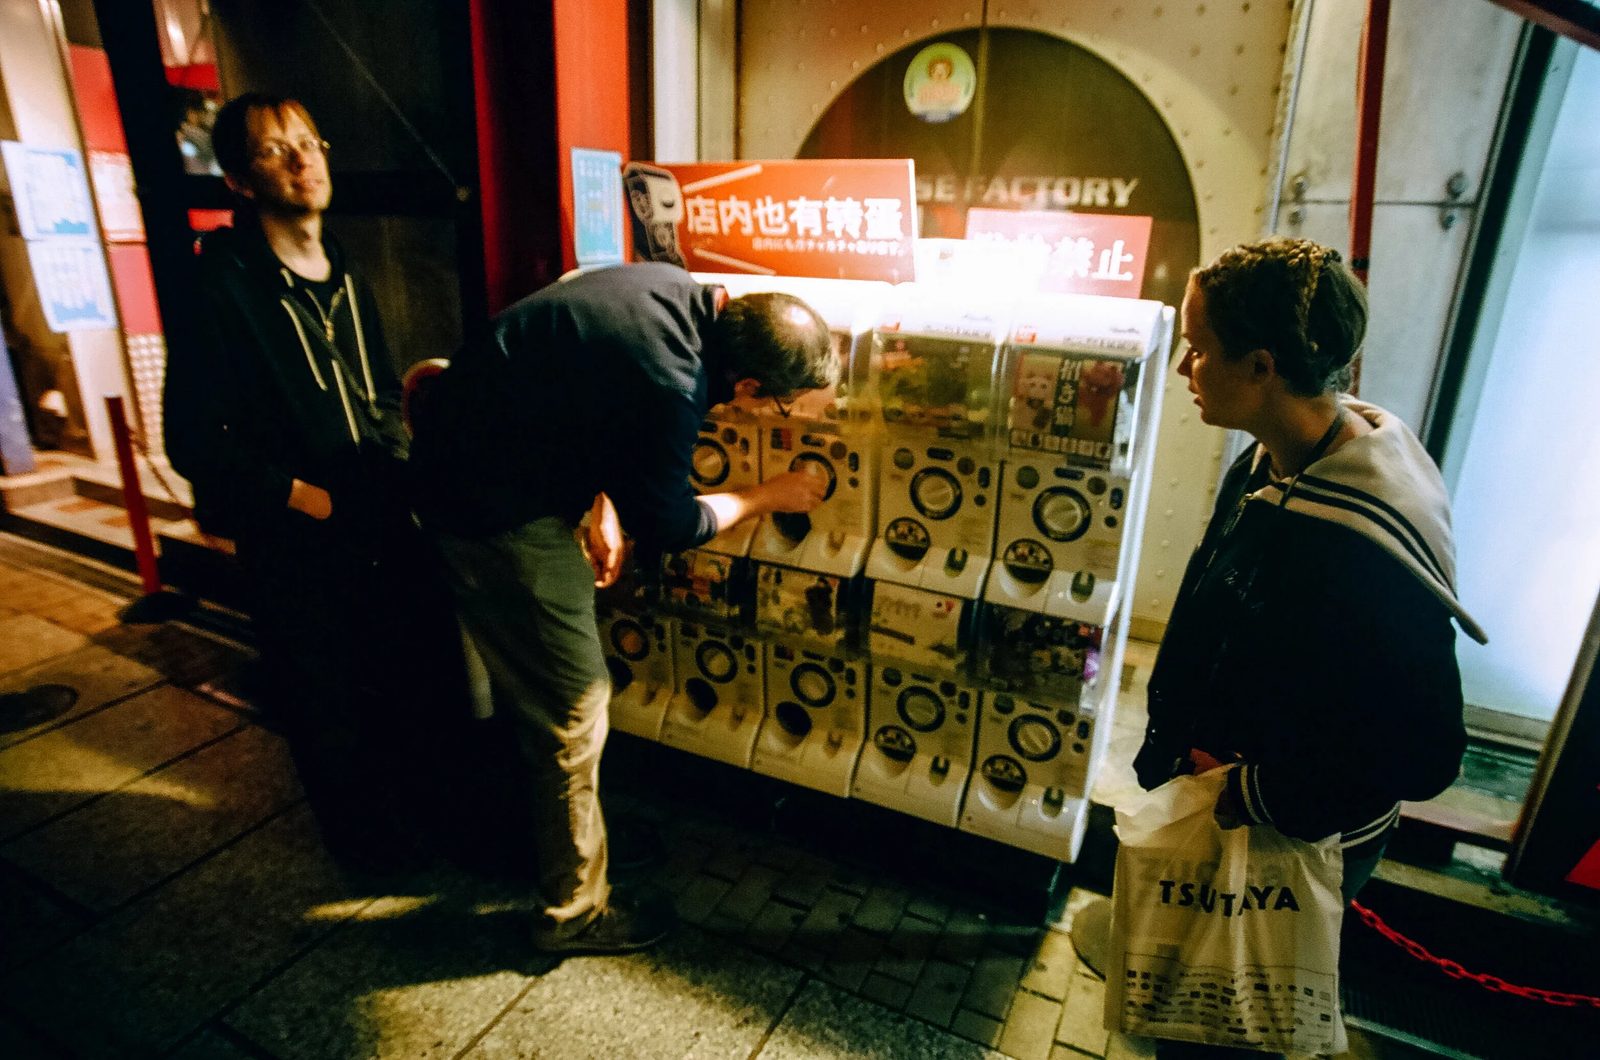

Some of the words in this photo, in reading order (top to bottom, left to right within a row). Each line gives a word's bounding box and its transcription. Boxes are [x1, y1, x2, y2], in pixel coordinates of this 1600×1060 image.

[963, 176, 1140, 208] FACTORY
[686, 195, 904, 237] 店内也有转蛋
